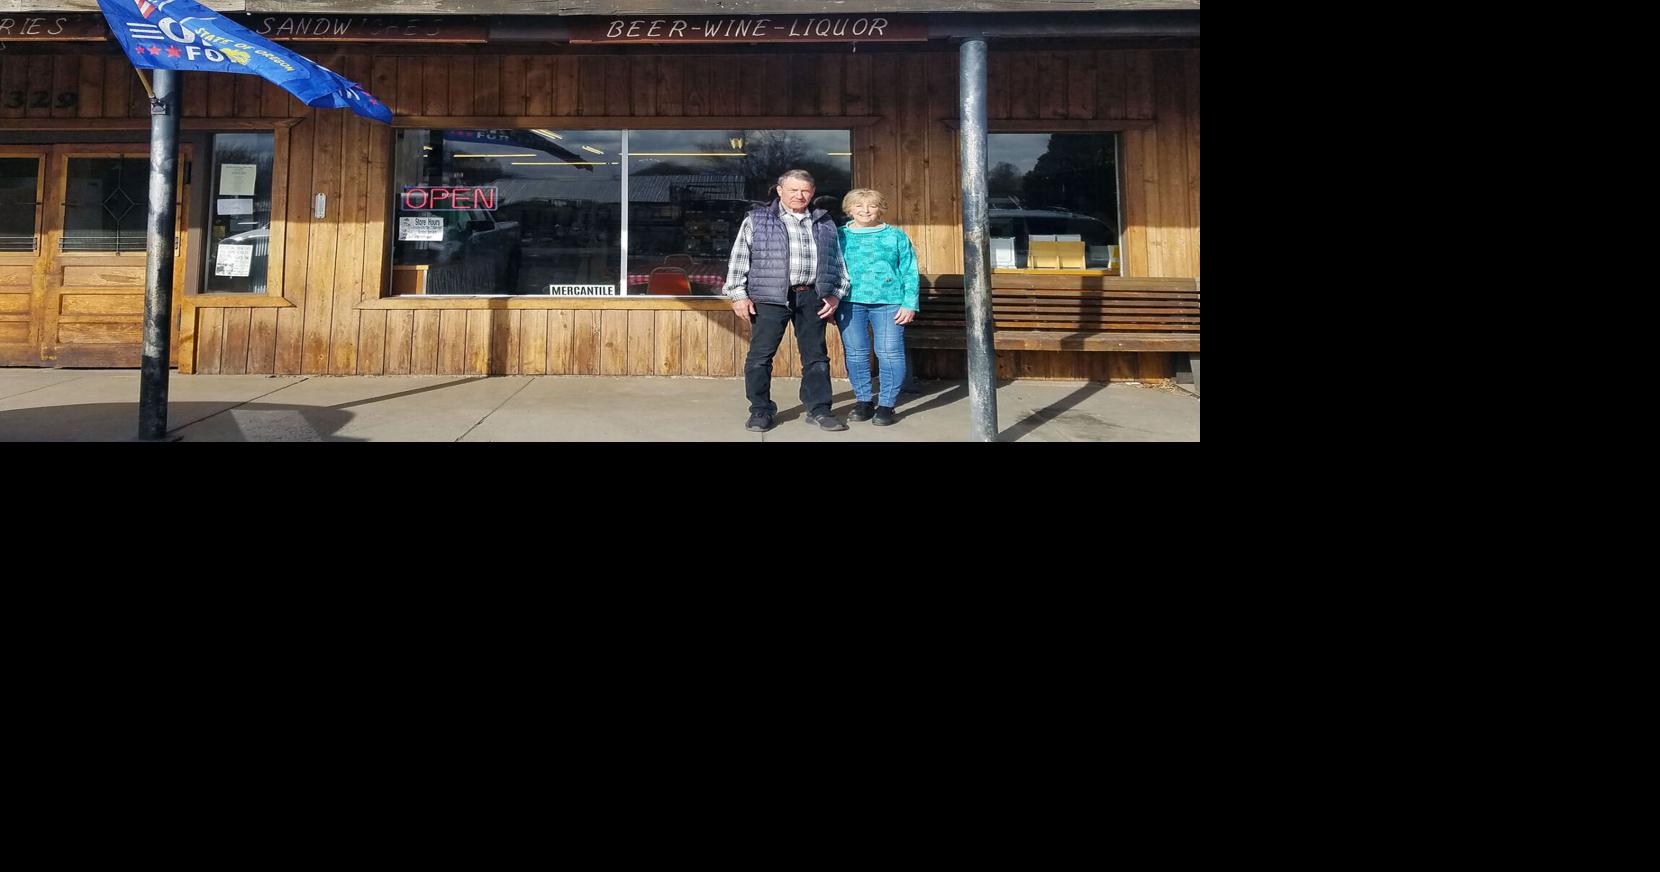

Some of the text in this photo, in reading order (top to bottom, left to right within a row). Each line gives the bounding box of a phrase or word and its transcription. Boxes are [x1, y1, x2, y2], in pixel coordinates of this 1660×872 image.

[194, 27, 234, 44] STATE
[254, 49, 295, 72] OREGON
[406, 188, 494, 209] OPEN
[415, 217, 427, 226] Store
[552, 286, 613, 295] MERCANTILE
